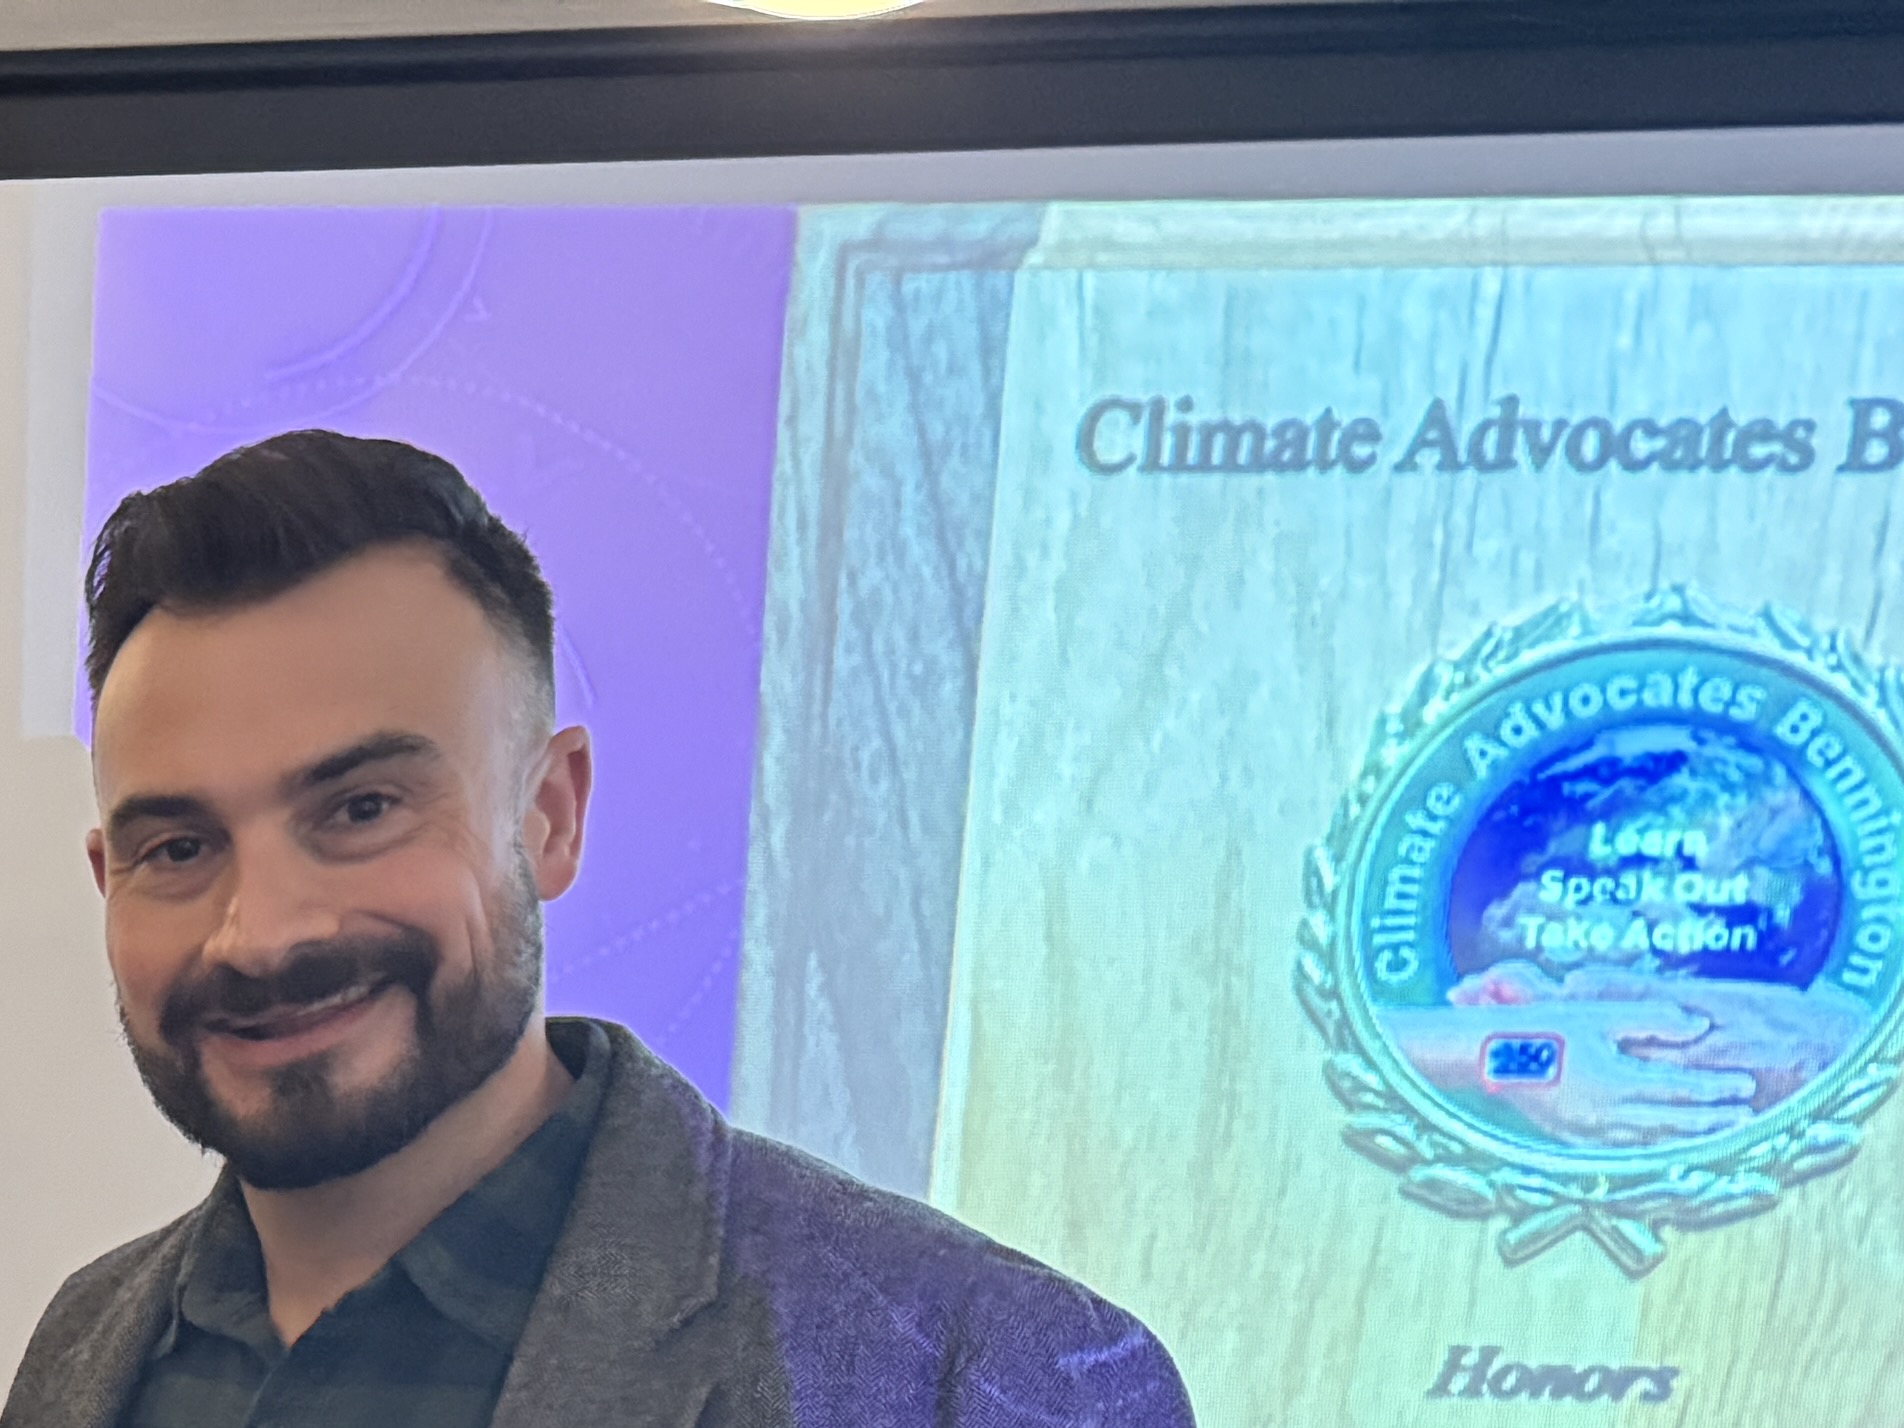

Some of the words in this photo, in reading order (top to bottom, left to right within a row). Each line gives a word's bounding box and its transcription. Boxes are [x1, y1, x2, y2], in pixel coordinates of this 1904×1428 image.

[1077, 395, 1381, 474] Climate
[1394, 395, 1816, 474] Advocates
[1371, 783, 1460, 984] Climate
[1465, 666, 1767, 779] Advocates
[1773, 698, 1901, 987] Bennington
[1589, 821, 1708, 859] Learn
[1540, 869, 1665, 909] Speak
[1673, 872, 1749, 905] Out
[1519, 915, 1615, 949] Take
[1621, 917, 1758, 953] Action
[1427, 1345, 1681, 1403] Honors
